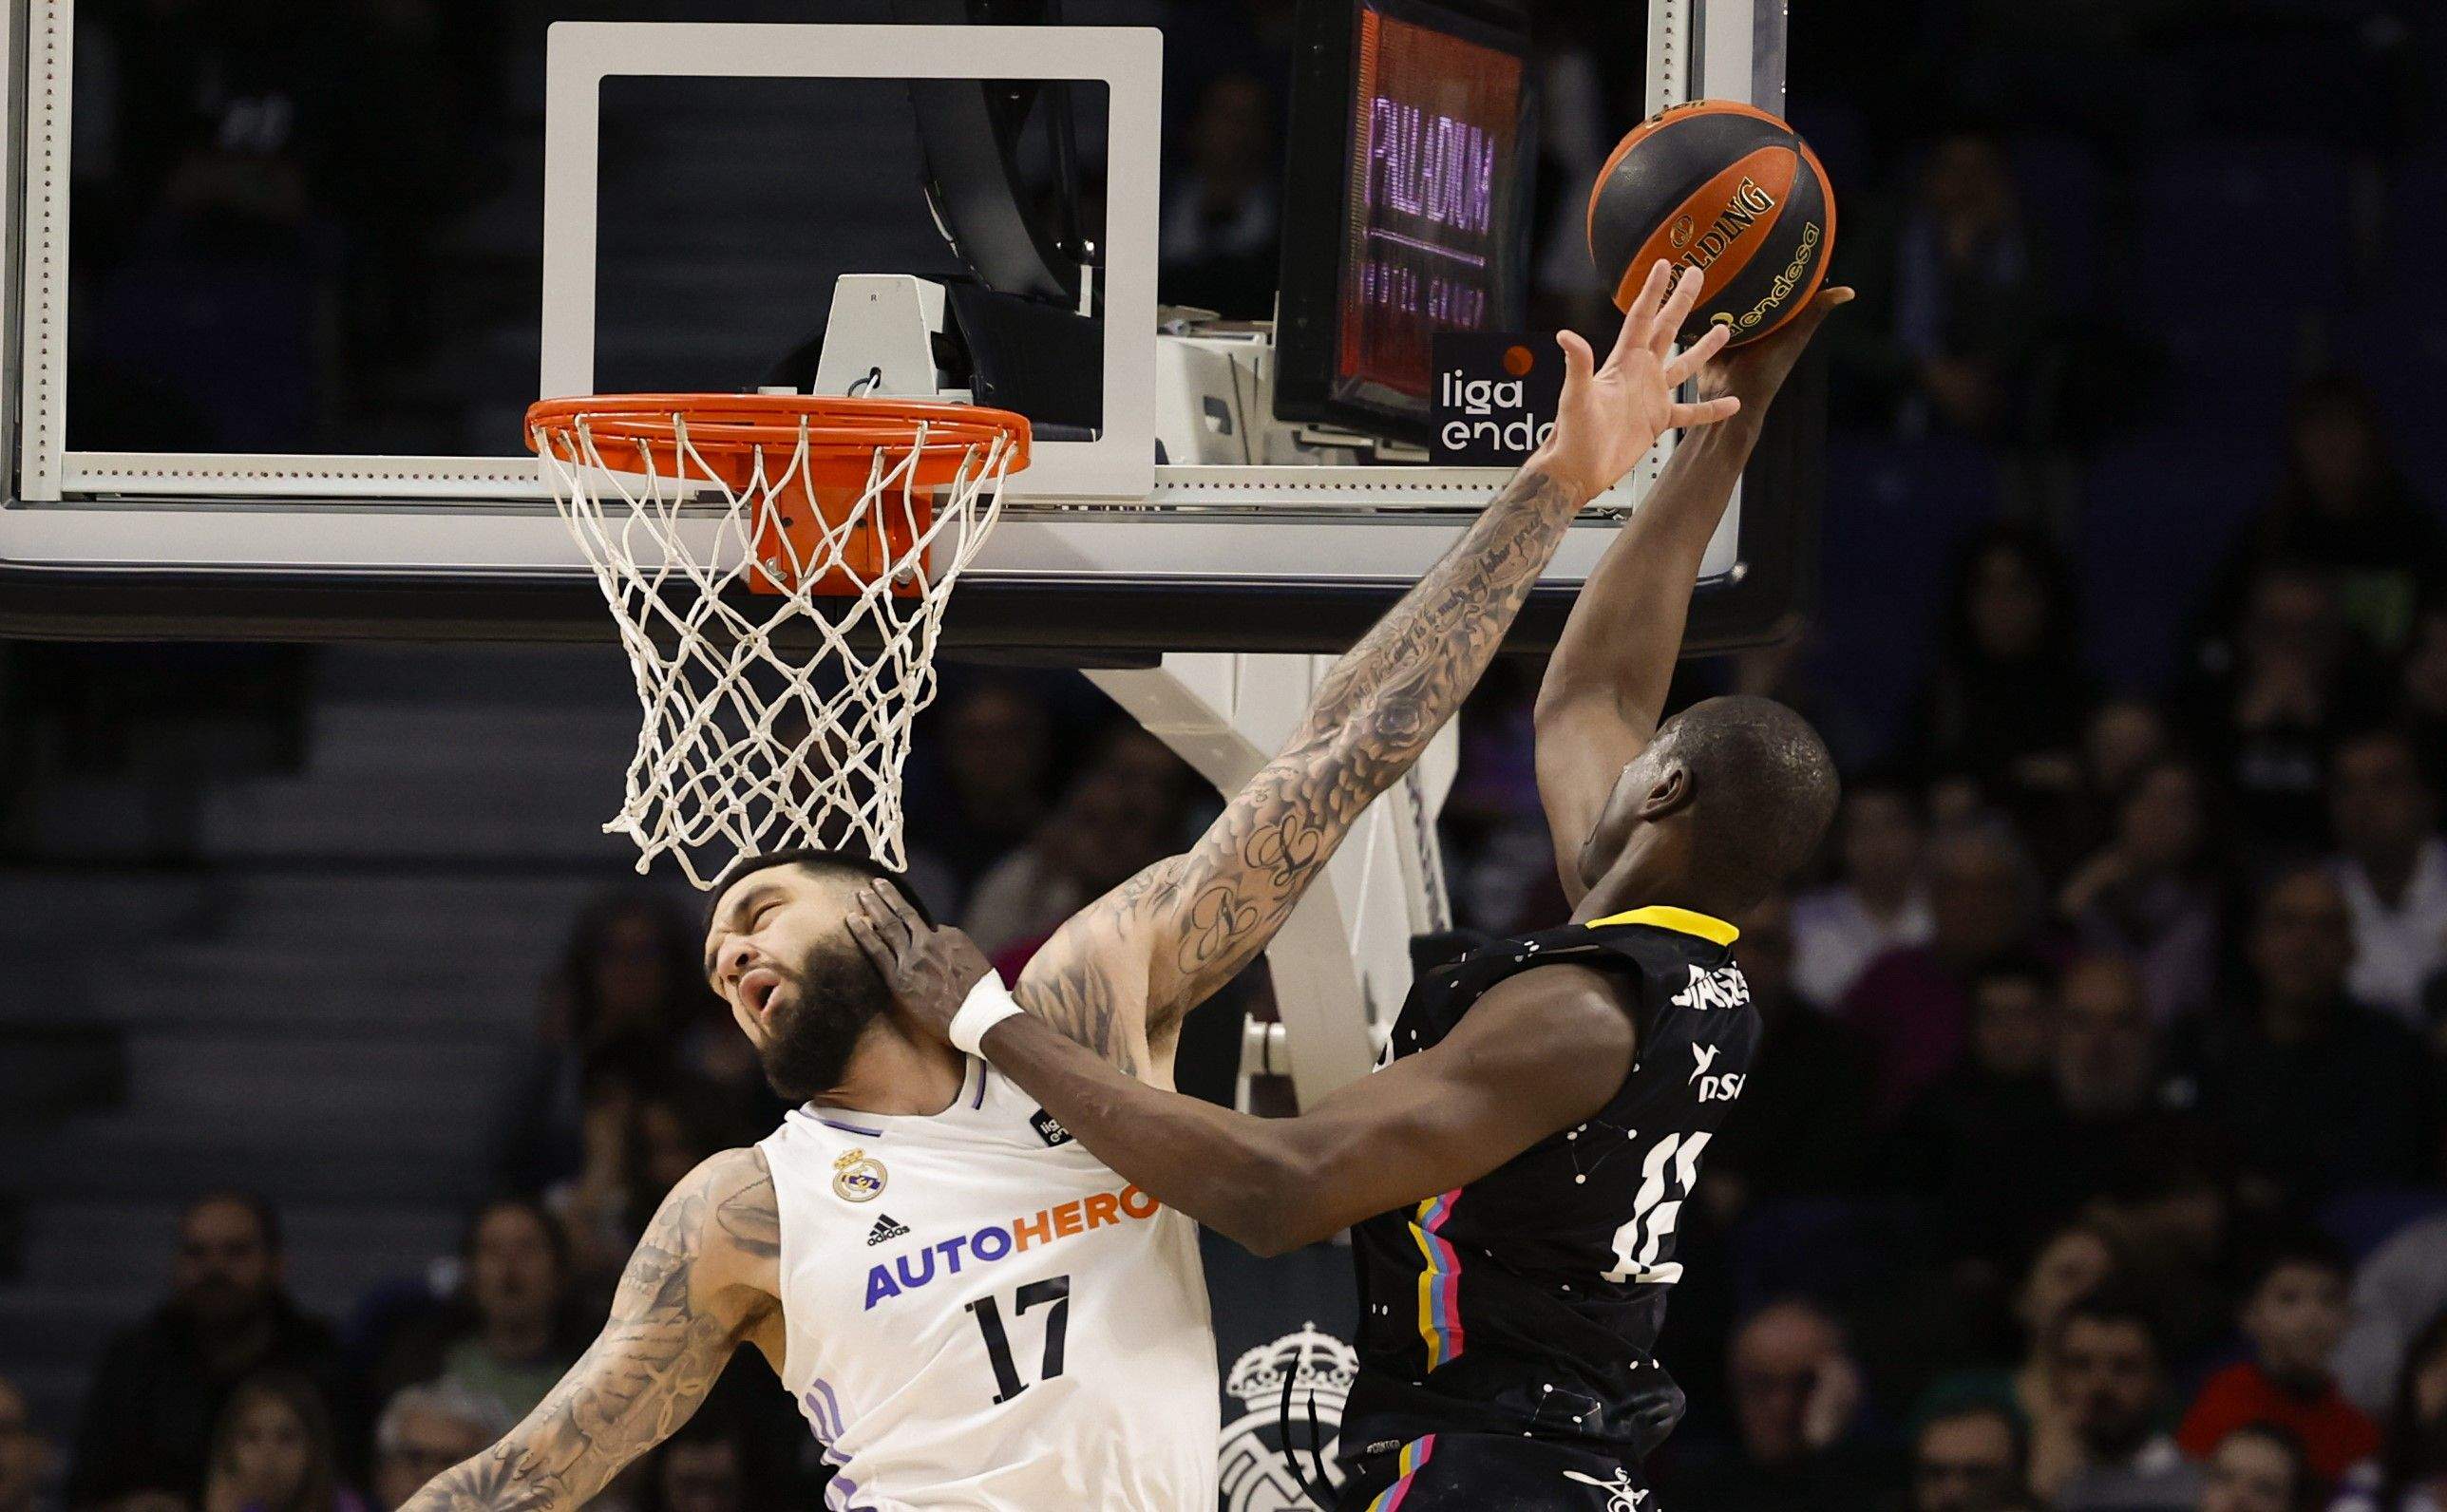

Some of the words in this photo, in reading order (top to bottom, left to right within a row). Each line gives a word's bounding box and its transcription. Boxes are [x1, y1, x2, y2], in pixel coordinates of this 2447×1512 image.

[1738, 221, 1820, 328] endesa
[1442, 369, 1523, 414] liga
[865, 1183, 1161, 1312] AUTOHERO
[866, 1224, 910, 1247] adidas
[964, 1275, 1070, 1406] 17
